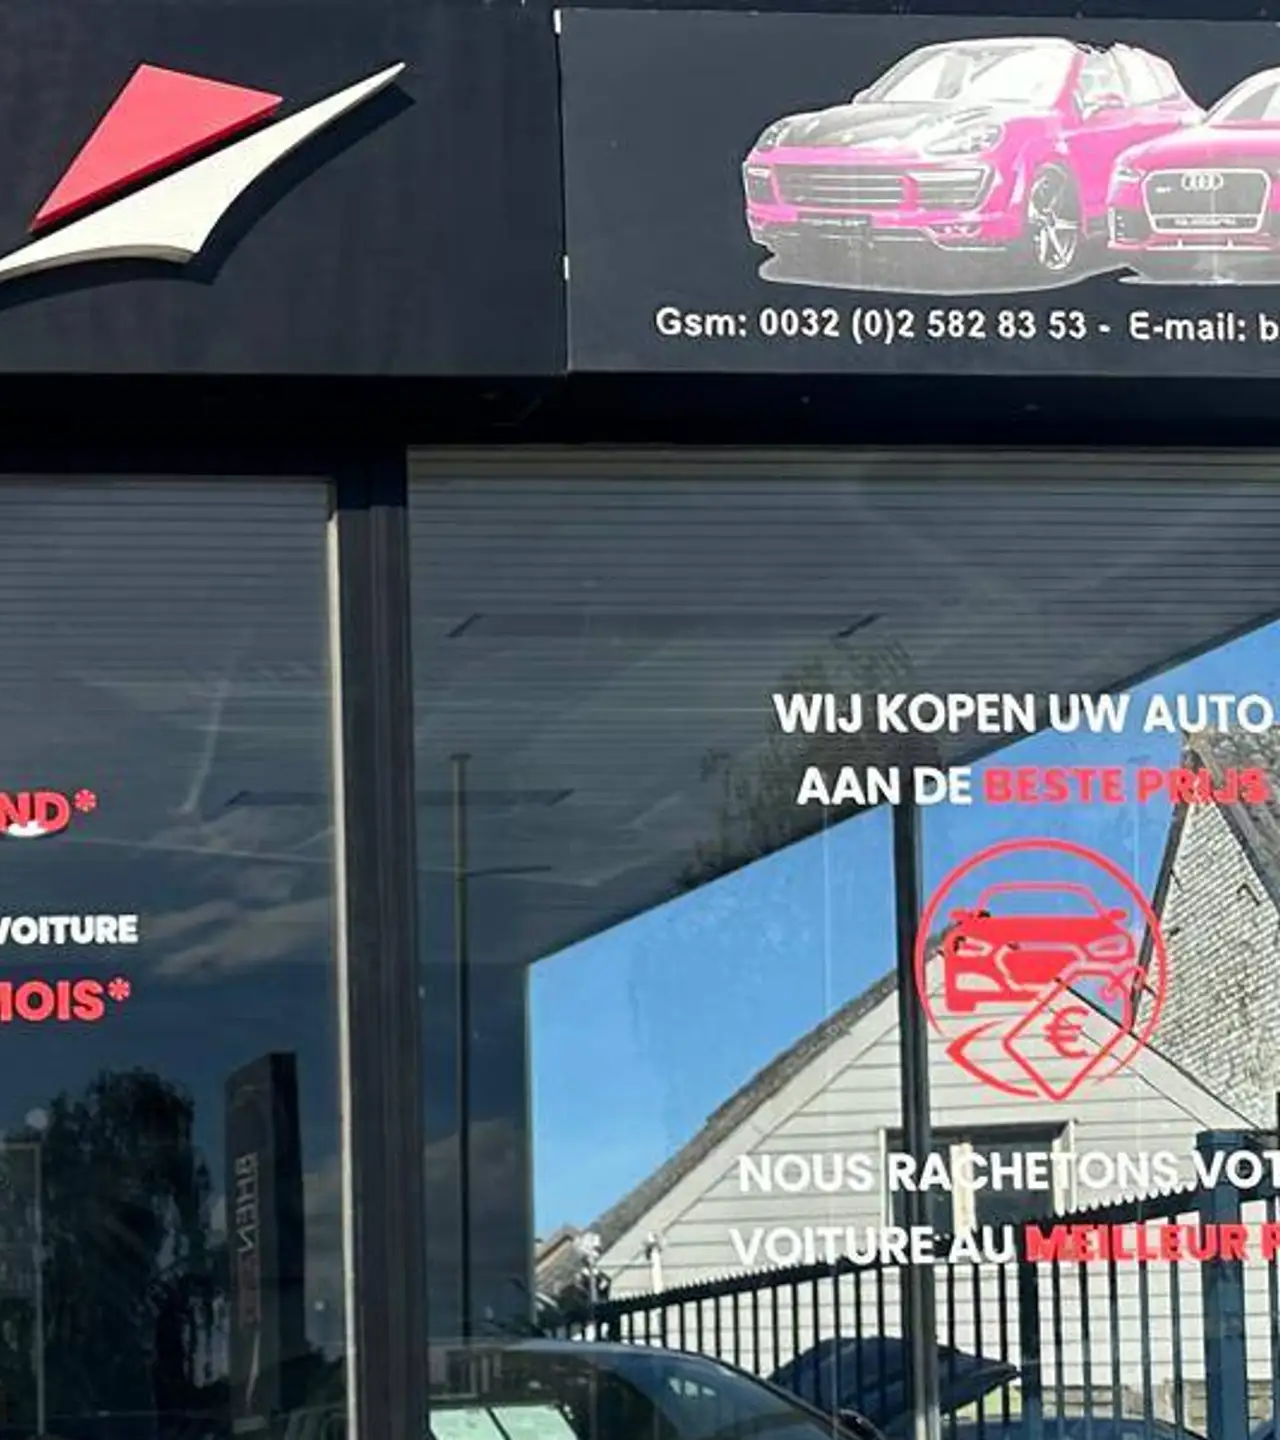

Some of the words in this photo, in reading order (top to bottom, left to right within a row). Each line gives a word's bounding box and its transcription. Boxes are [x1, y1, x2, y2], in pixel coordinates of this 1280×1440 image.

[654, 306, 747, 338] Gsm:
[759, 307, 841, 338] 0032
[851, 307, 915, 345] (0)2
[926, 309, 987, 339] 582
[997, 309, 1037, 339] 83
[1048, 310, 1088, 341] 53
[1129, 310, 1247, 342] E-mail:
[772, 693, 863, 734] WIJ
[876, 693, 1037, 734] KOPEN
[1048, 693, 1131, 734] UW
[1144, 693, 1273, 735] AUTO
[796, 765, 901, 806] AAN
[913, 765, 974, 806] DE
[981, 765, 1124, 805] BESTE
[1135, 766, 1270, 806] PRIJS
[739, 1152, 873, 1192] NOUS
[888, 1150, 1178, 1191] RACHETONS
[730, 1226, 933, 1265] VOITURE
[948, 1226, 1014, 1264] AU
[1025, 1223, 1249, 1262] MEILLEUR
